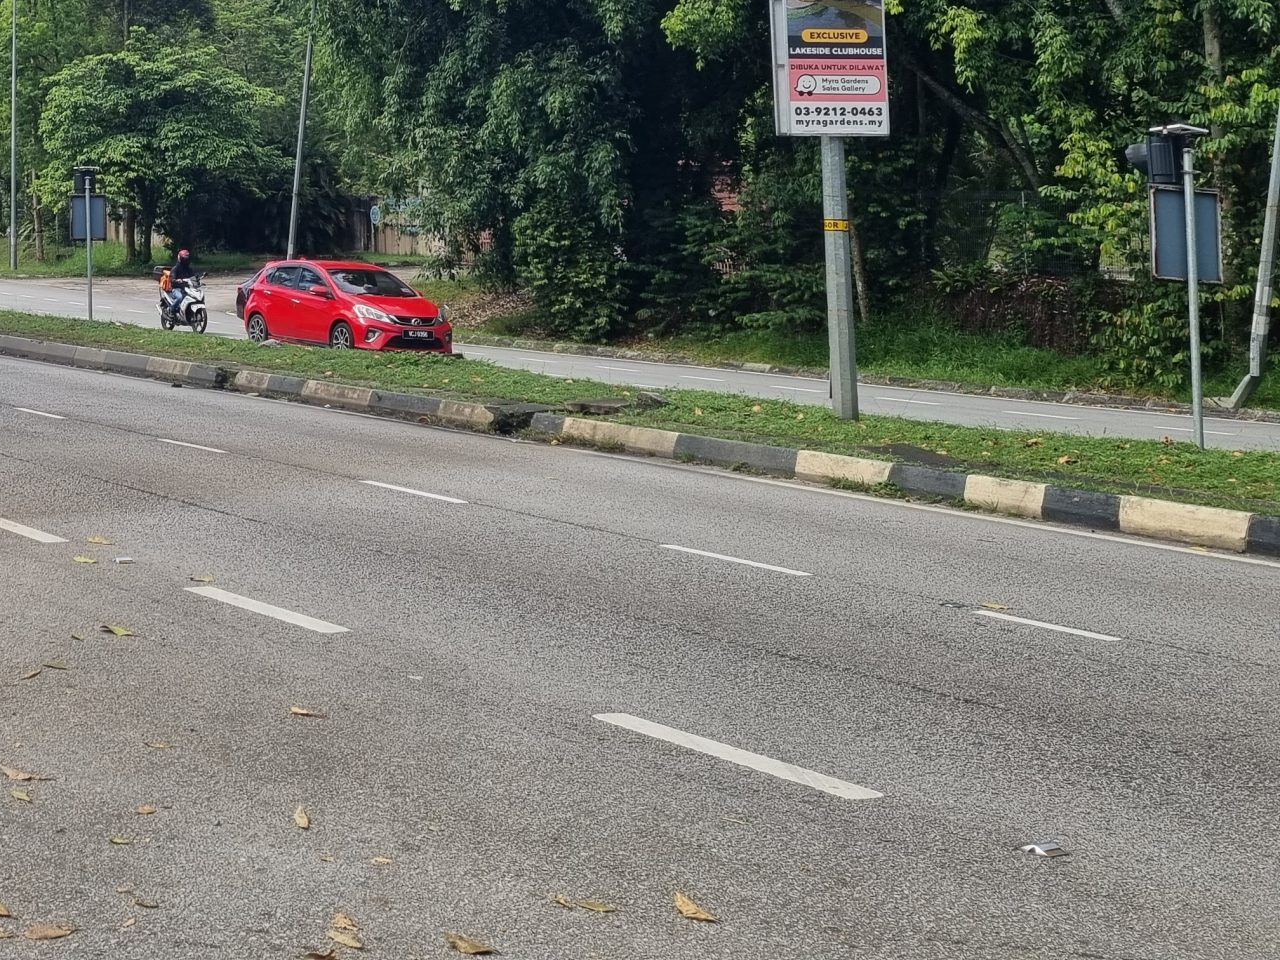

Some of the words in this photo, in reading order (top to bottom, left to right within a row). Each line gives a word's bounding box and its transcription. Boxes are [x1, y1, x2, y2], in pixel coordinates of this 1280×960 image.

[809, 31, 861, 40] EXCLUSIVE
[789, 47, 831, 55] LAKESIDE
[832, 47, 883, 55] CLUBHOUSE
[790, 63, 819, 71] DIBUKA
[821, 77, 839, 85] Myra
[841, 85, 866, 93] Gallery
[794, 106, 883, 117] 03-9212-0463
[795, 117, 883, 128] myragardens.my
